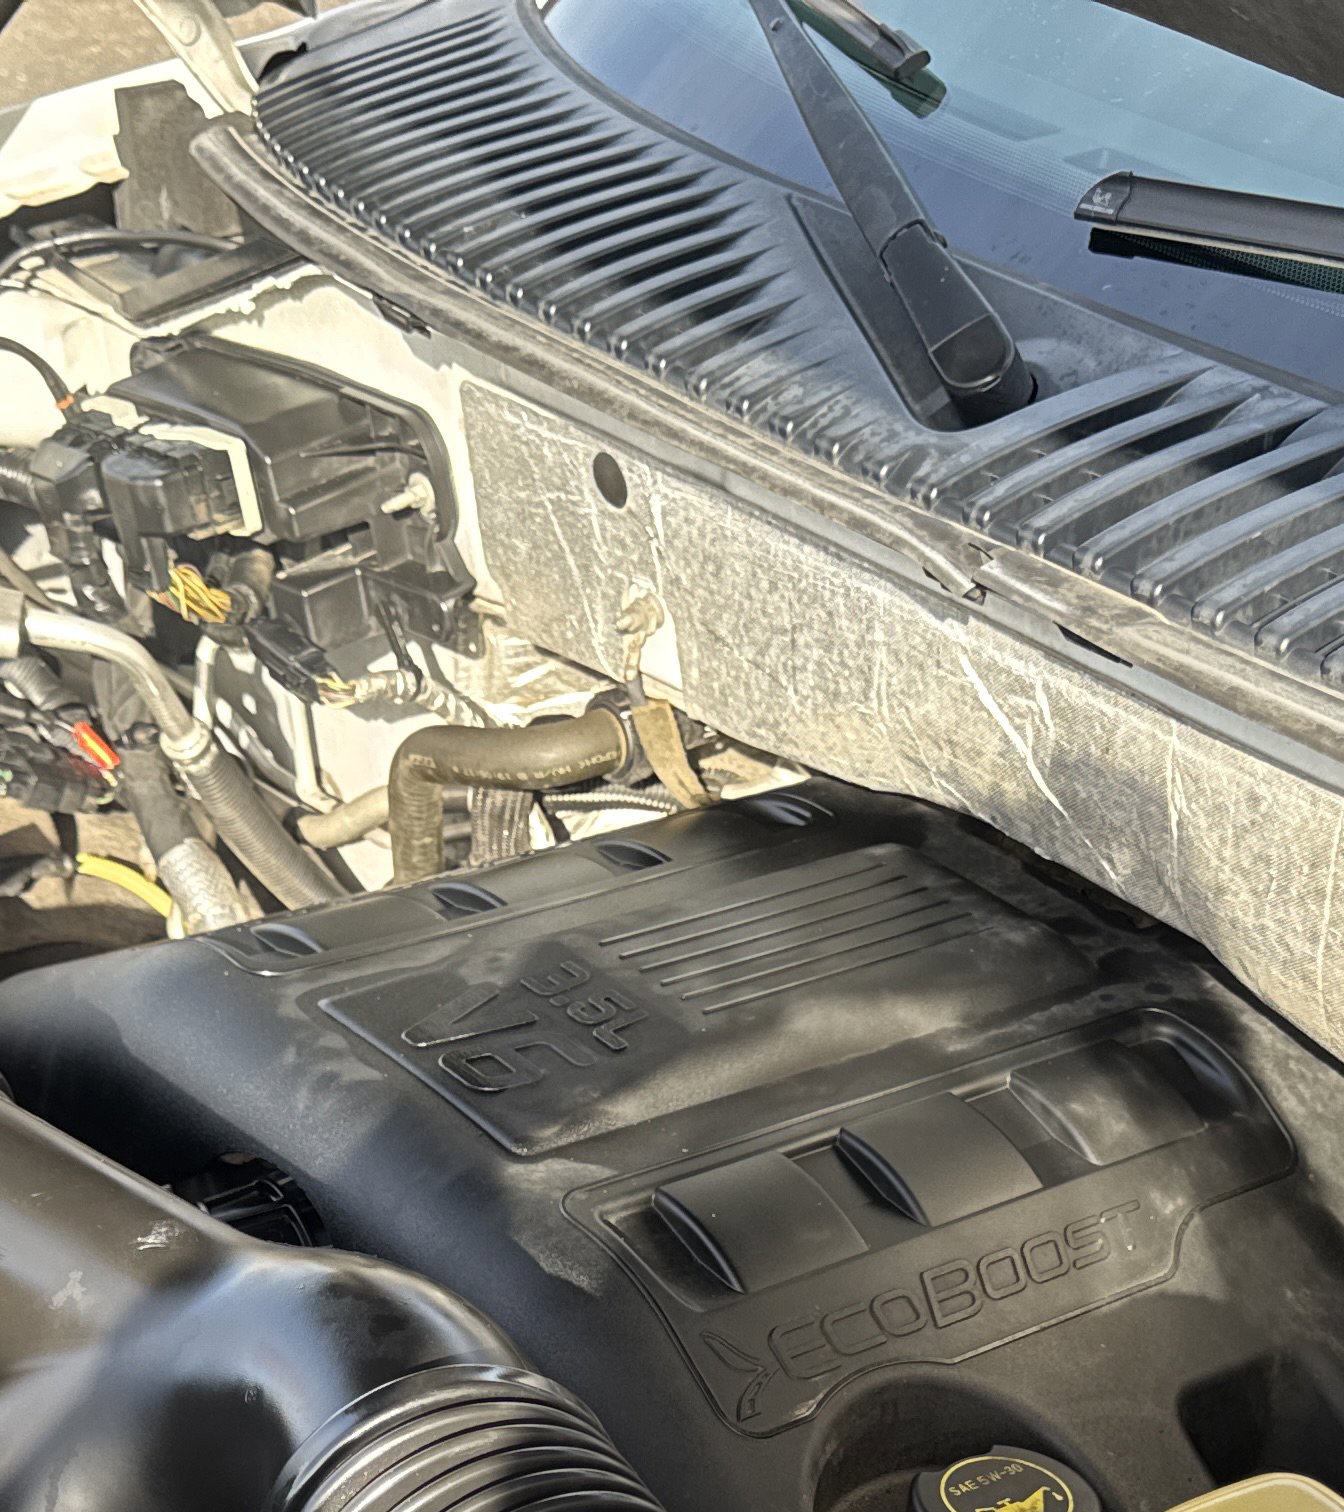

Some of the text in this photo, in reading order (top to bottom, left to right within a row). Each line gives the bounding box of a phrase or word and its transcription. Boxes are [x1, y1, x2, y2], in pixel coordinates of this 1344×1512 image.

[400, 981, 598, 1092] V6
[519, 960, 649, 1051] 3.5L
[948, 1462, 1025, 1497] SAE 5W-30
